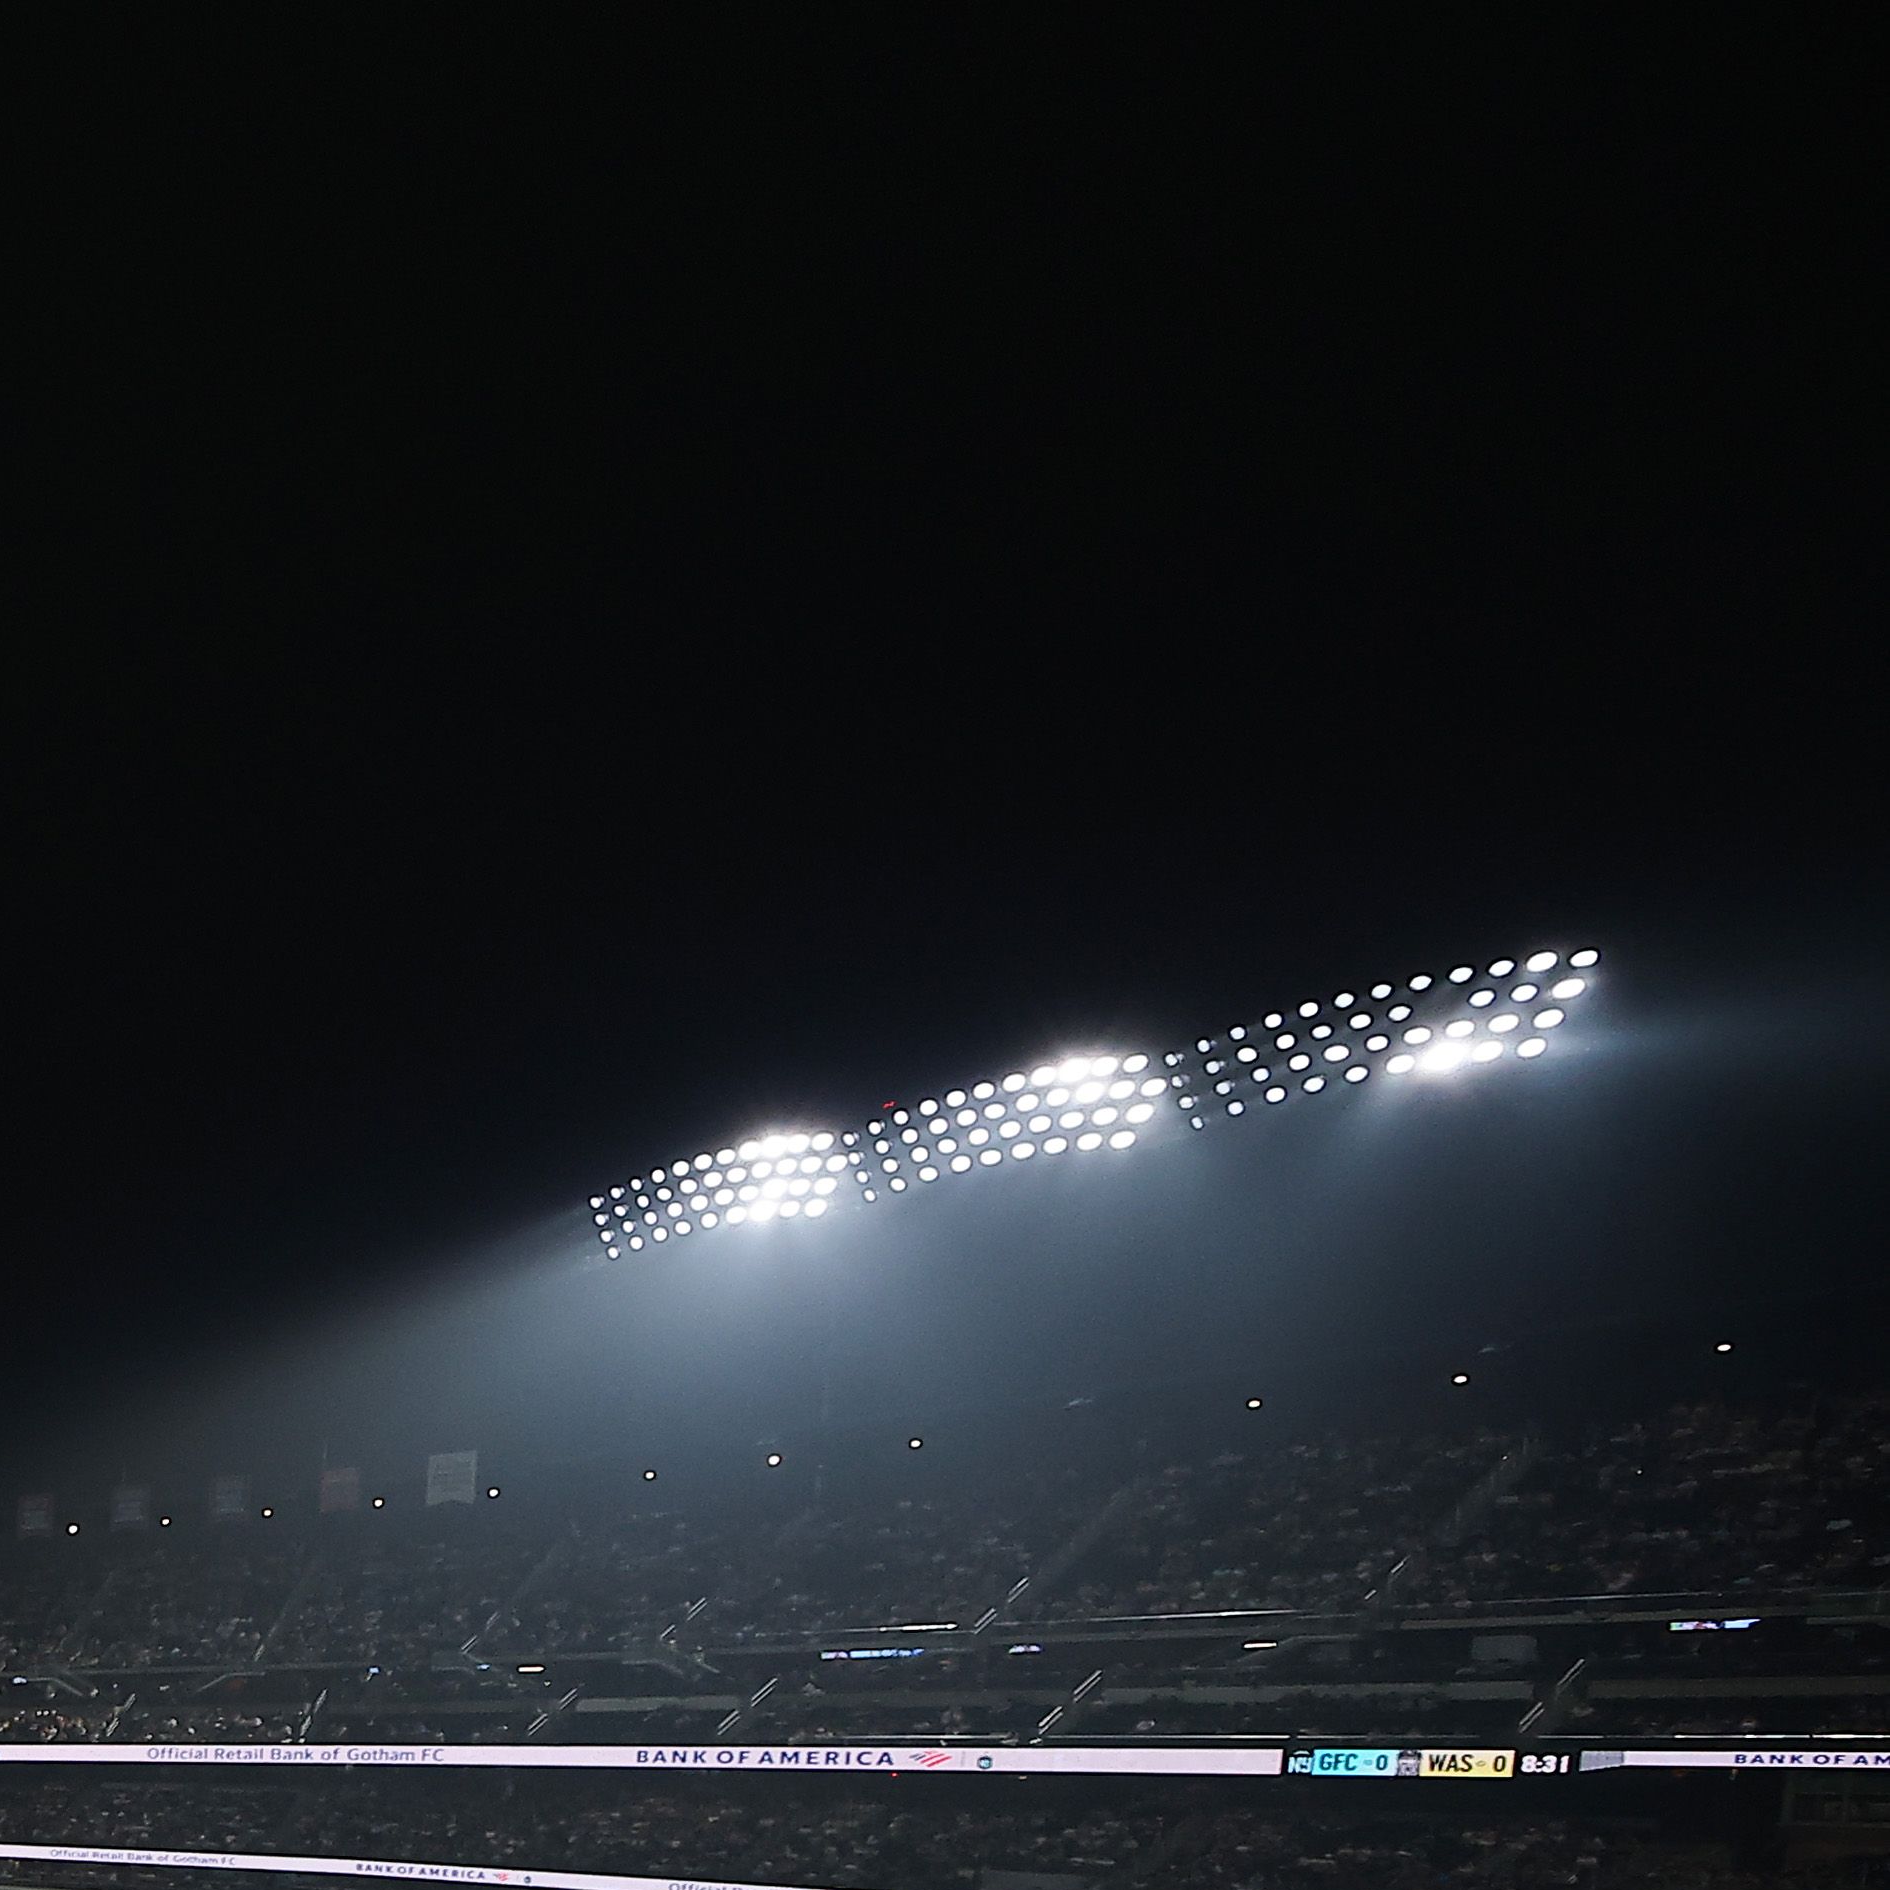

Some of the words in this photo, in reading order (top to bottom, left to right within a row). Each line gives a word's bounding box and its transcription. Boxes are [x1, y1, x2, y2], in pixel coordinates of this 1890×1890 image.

[147, 1747, 209, 1760] Official
[215, 1747, 264, 1760] Retail
[270, 1748, 314, 1761] Bank
[320, 1748, 340, 1761] of
[346, 1748, 415, 1764] Gotham
[421, 1749, 445, 1762] FC
[636, 1750, 707, 1764] BANK
[716, 1750, 750, 1765] OF
[758, 1751, 894, 1766] AMERICA
[1320, 1755, 1357, 1771] GFC
[1375, 1754, 1388, 1770] 0
[1428, 1754, 1472, 1772] WAS
[1493, 1755, 1506, 1772] 0
[1520, 1756, 1569, 1773] 8:31
[1734, 1753, 1802, 1764] BANK
[1812, 1754, 1846, 1765] OF
